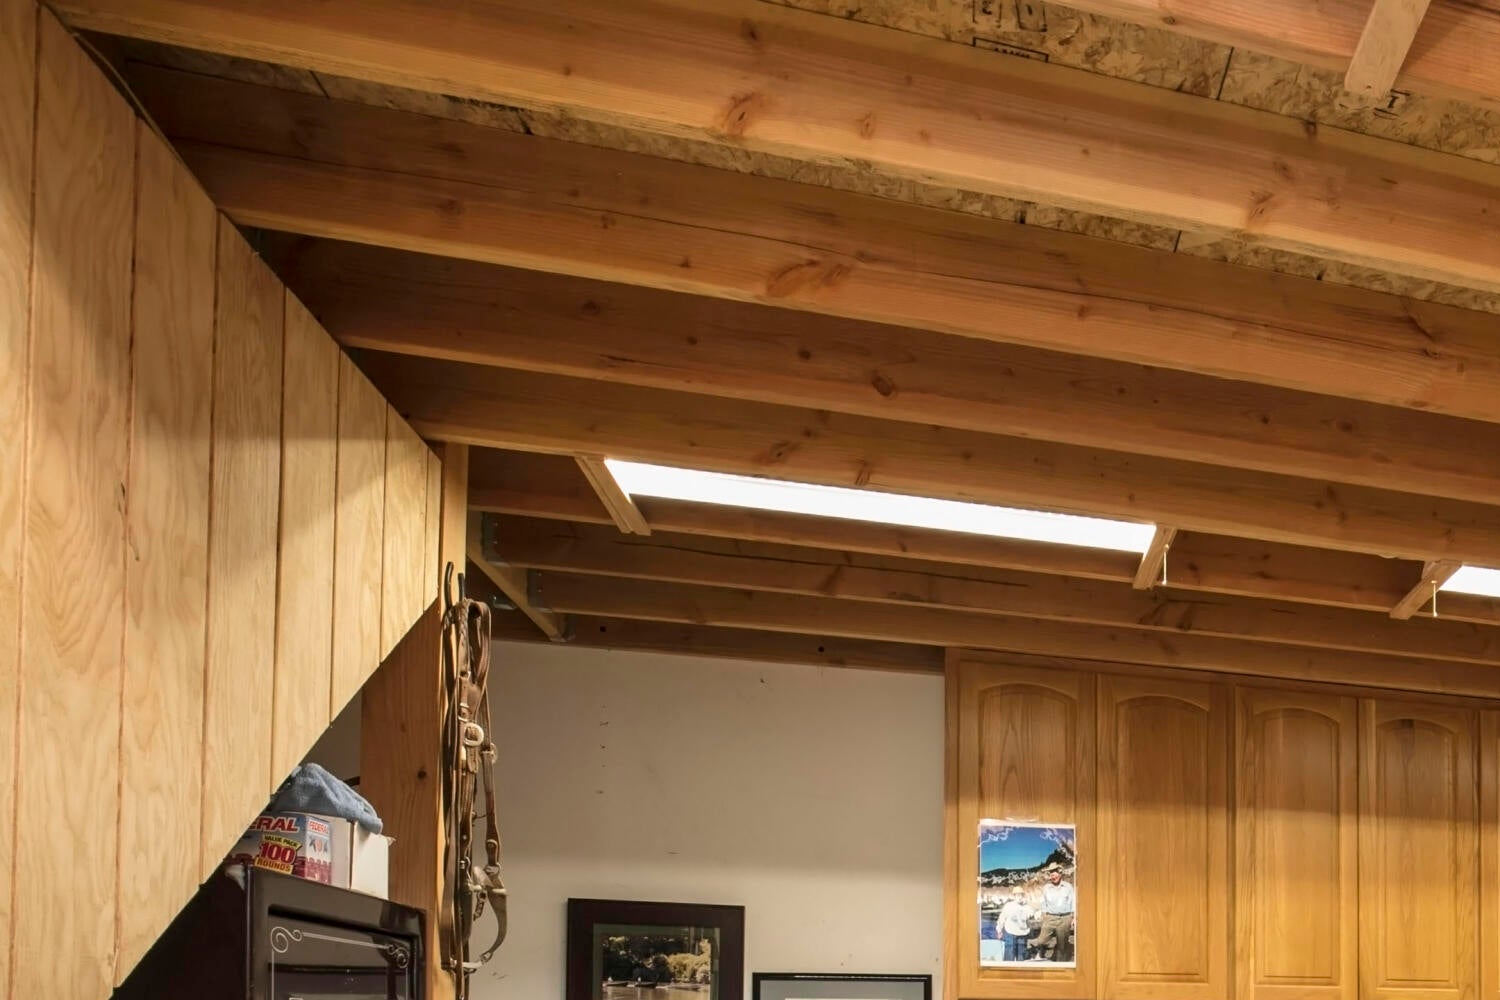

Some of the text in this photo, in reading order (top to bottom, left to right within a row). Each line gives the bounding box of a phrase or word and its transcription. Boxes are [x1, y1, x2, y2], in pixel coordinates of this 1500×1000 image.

[264, 834, 298, 847] VALUE PACK
[260, 841, 297, 864] 100
[256, 857, 291, 872] ROUNDS
